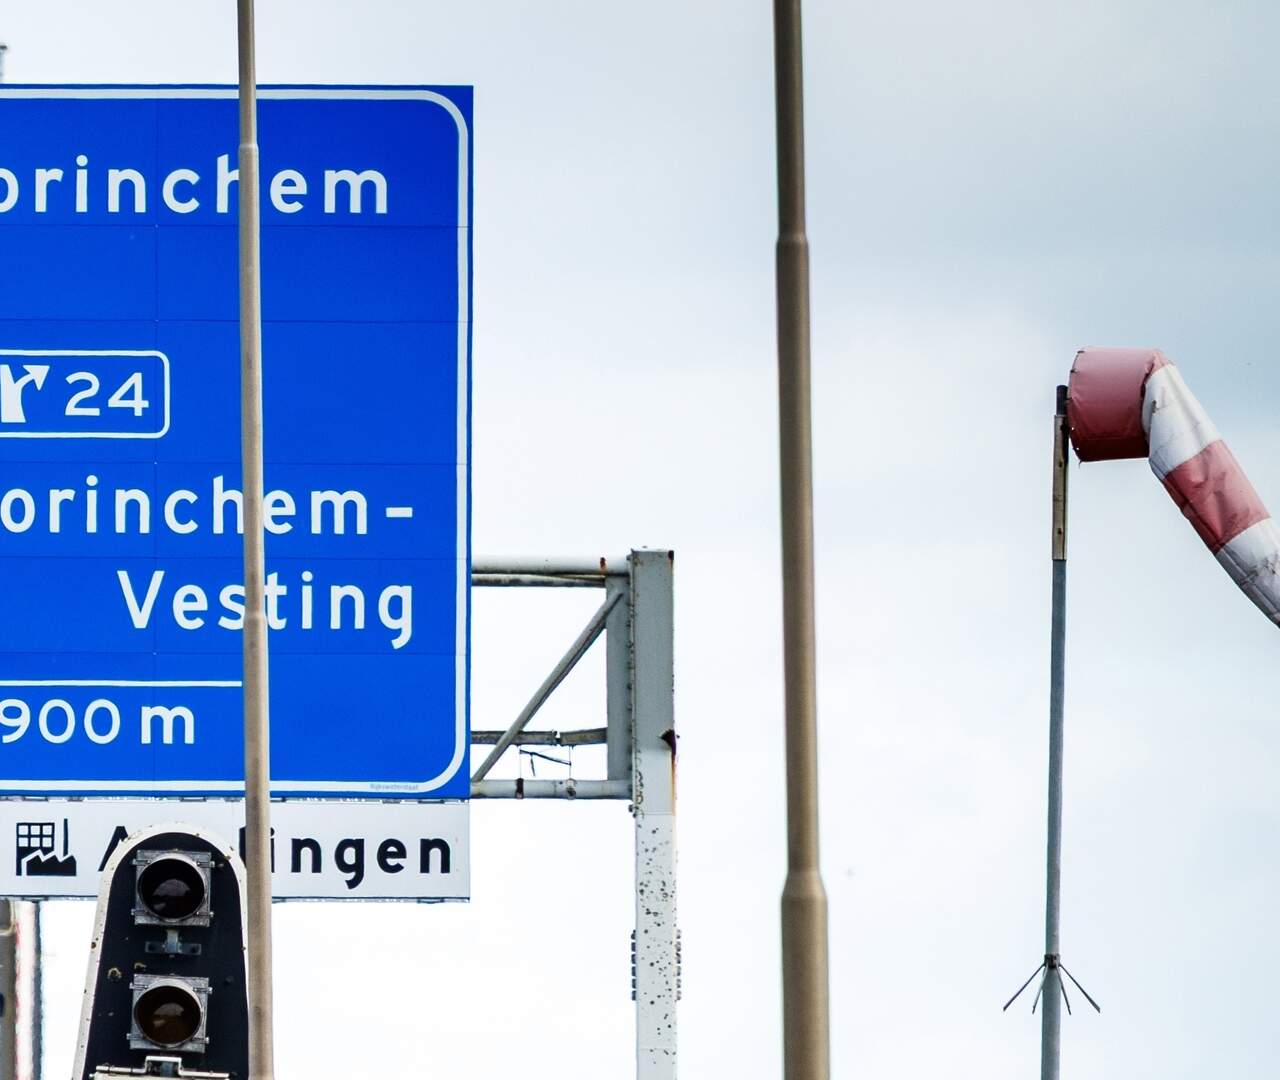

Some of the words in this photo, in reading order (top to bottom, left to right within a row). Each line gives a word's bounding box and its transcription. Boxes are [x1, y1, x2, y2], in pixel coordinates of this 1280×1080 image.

[65, 371, 150, 417] 24
[117, 568, 413, 649] Vesting
[140, 704, 197, 746] m
